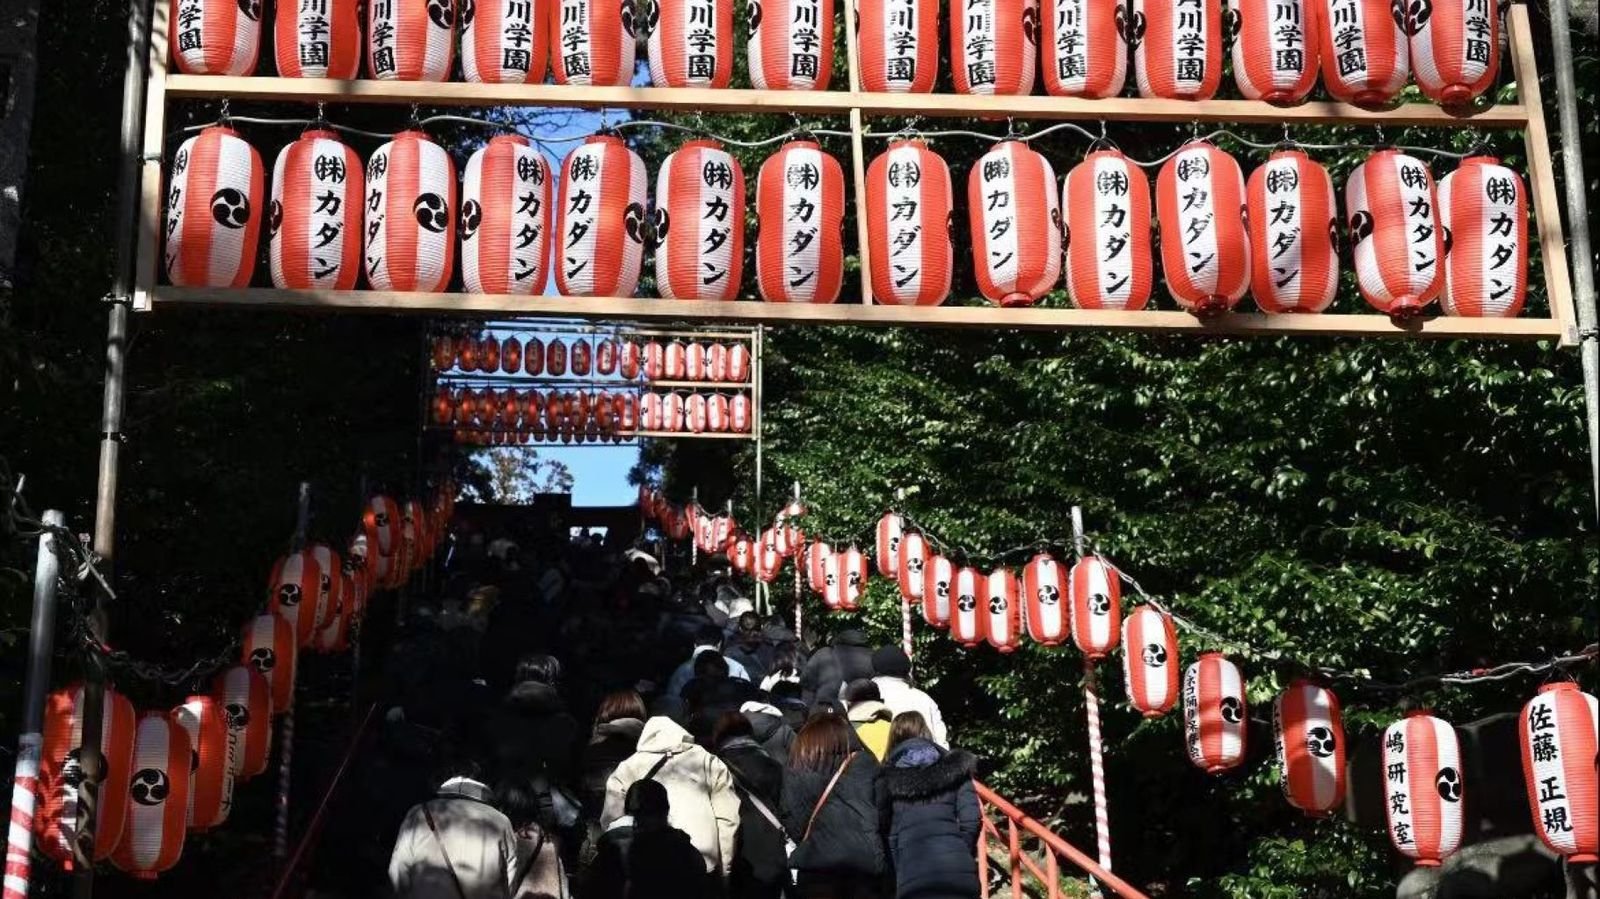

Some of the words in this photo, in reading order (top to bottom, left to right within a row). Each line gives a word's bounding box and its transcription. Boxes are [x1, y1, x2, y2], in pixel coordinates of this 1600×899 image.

[178, 0, 202, 51] 学園
[372, 0, 395, 74] 川学園
[503, 0, 531, 73] 川学園
[562, 1, 590, 76] 川学園
[688, 0, 716, 80] 川学園
[792, 0, 819, 80] 川学園
[888, 0, 916, 82] 川学園
[967, 0, 996, 87] 川学園
[1057, 0, 1086, 80] 川学園
[1177, 0, 1205, 82] 川学園
[1333, 0, 1367, 77] 川学園
[1465, 0, 1491, 66] 川学園
[1386, 731, 1414, 844] 嶋研究室
